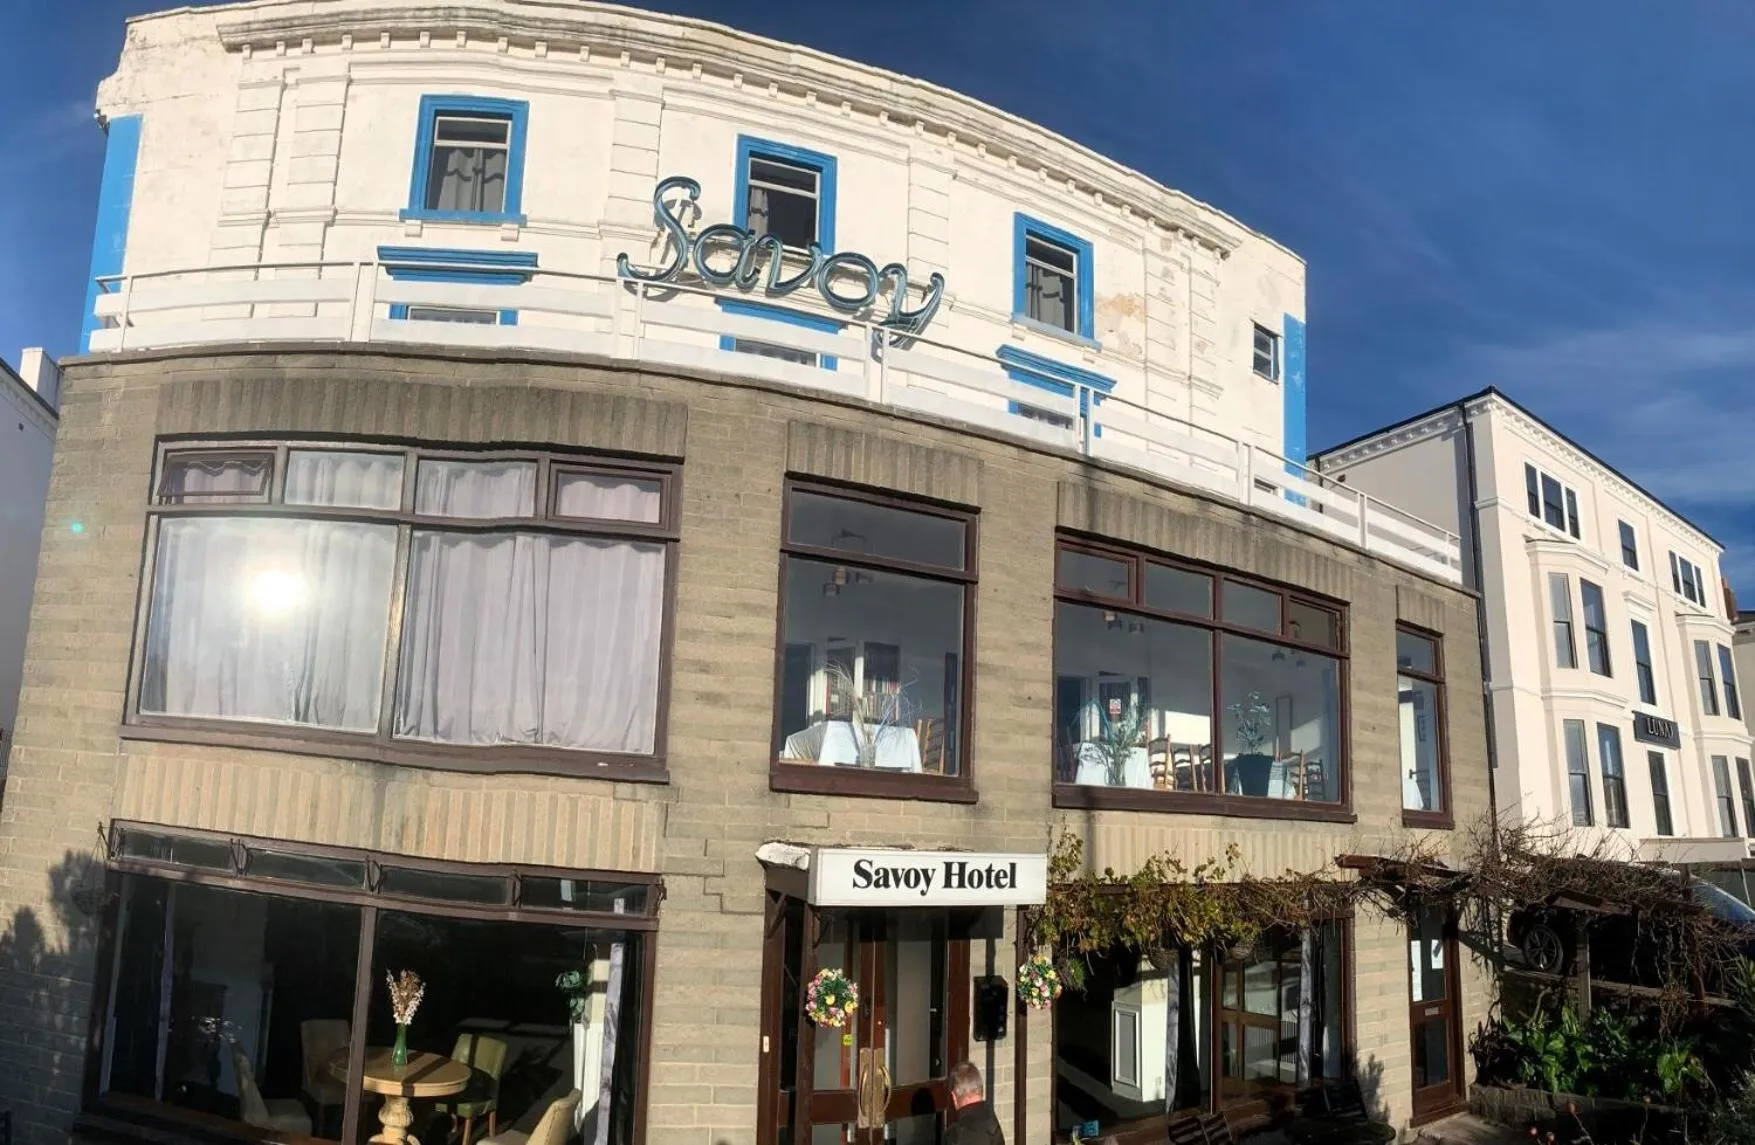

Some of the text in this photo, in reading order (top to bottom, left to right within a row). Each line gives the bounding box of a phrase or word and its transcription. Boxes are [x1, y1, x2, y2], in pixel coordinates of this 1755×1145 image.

[617, 176, 945, 348] Savoy
[853, 859, 1017, 896] Savoy Hotel
